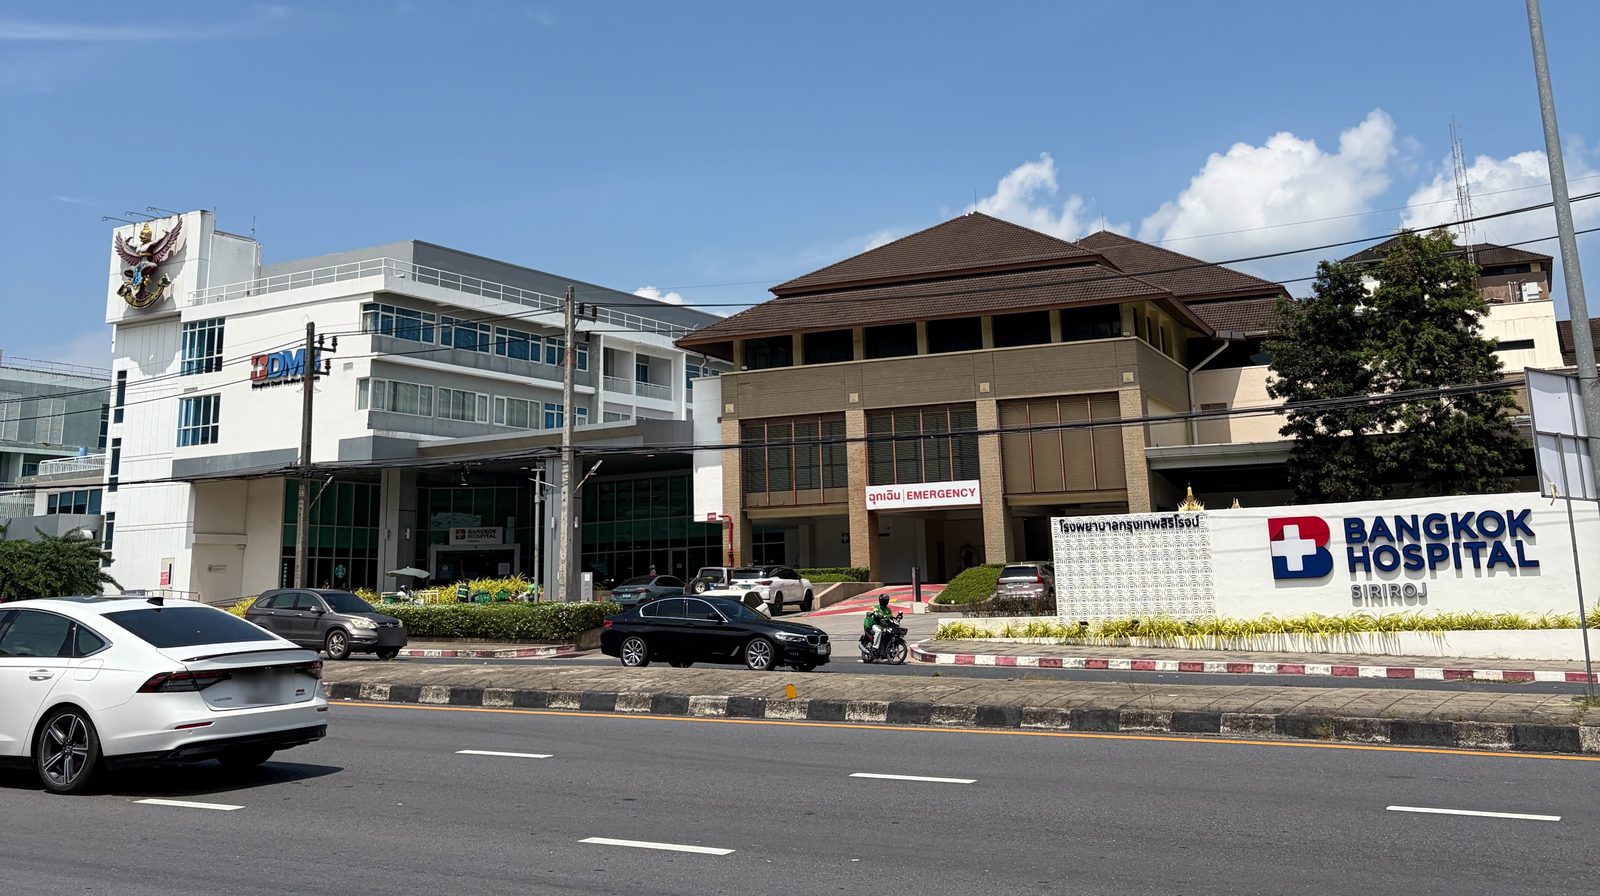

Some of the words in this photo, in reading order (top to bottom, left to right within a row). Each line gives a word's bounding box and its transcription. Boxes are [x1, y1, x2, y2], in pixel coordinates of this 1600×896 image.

[868, 490, 901, 505] ฉุกเฉิน
[906, 488, 976, 500] EMERGENCY
[1059, 514, 1200, 535] โรงพยาบาลกรุงเทพสิริโรจน์
[1343, 509, 1535, 543] BANGKOK
[1347, 540, 1540, 573] HOSPITAL
[1351, 582, 1427, 599] SIRIROJ
